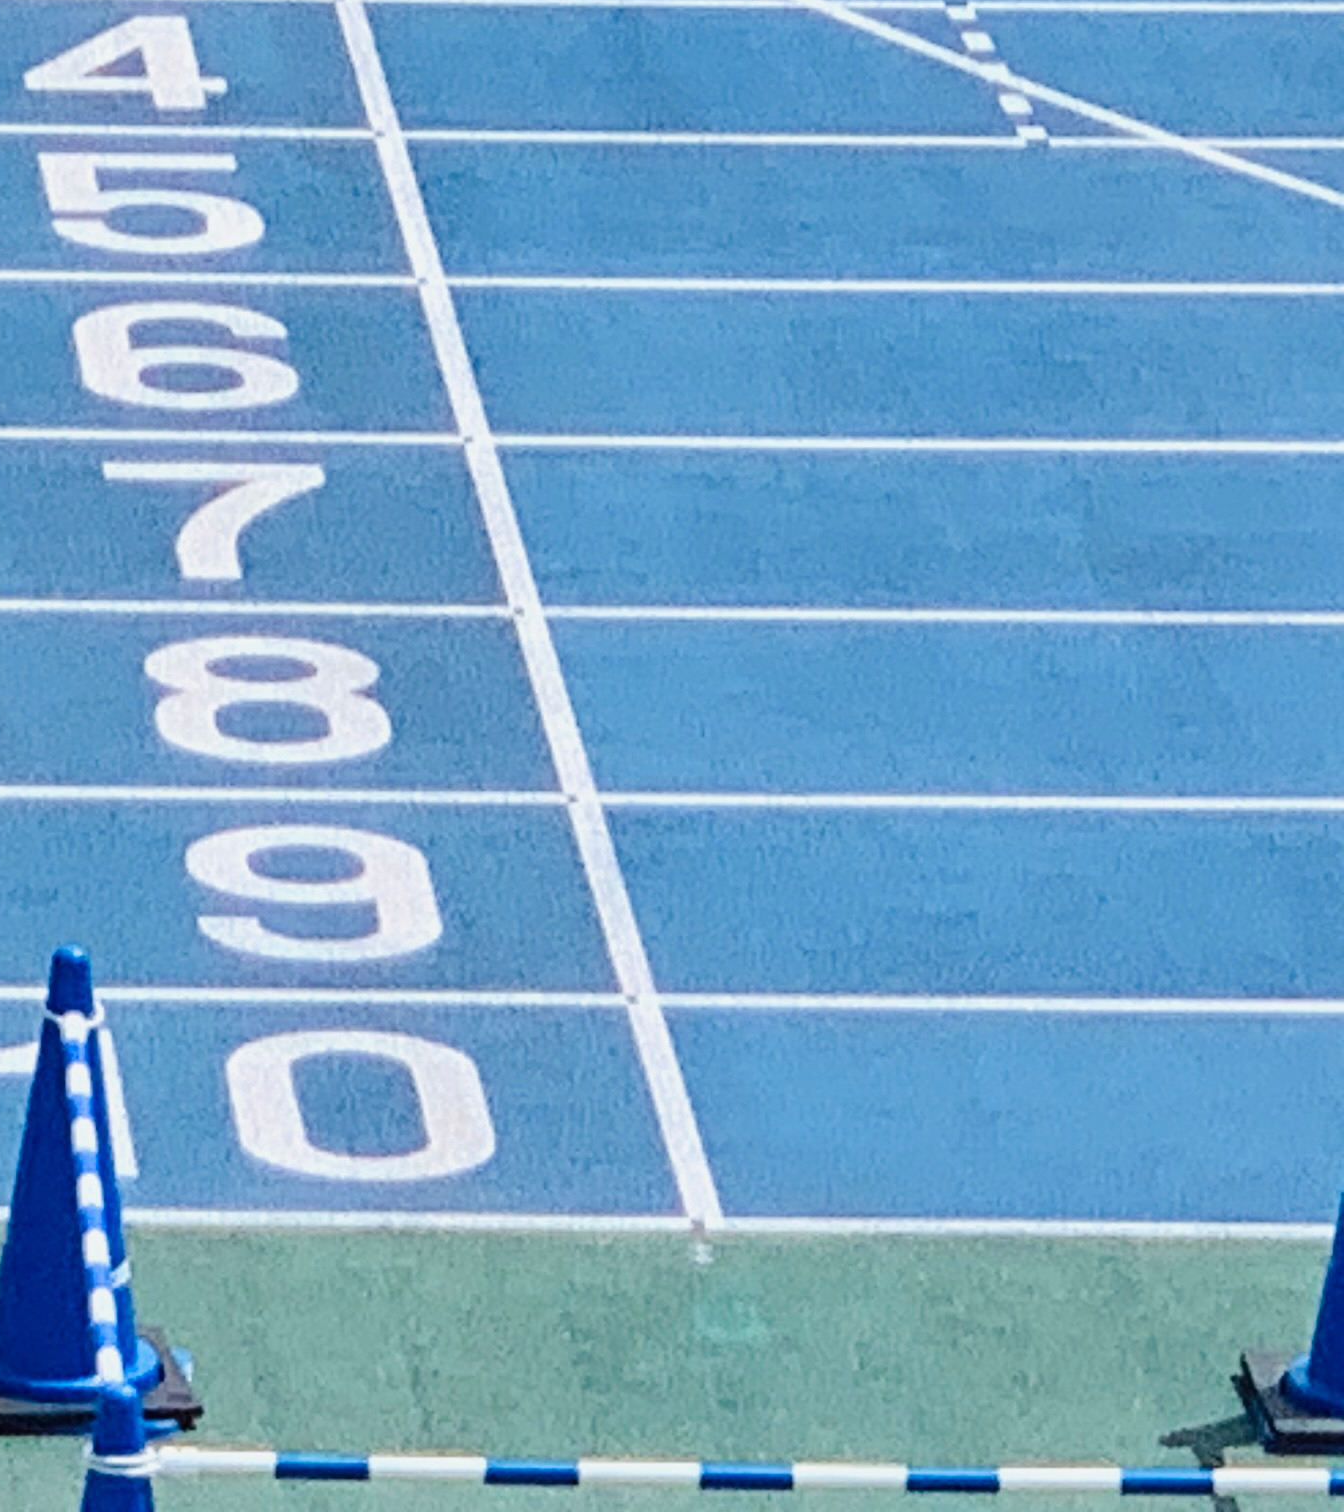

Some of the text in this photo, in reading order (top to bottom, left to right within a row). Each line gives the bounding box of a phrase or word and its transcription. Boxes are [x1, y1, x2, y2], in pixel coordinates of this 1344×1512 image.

[23, 15, 228, 110] 4
[37, 153, 266, 254] 5
[72, 301, 300, 409] 6
[102, 461, 327, 579] 7
[143, 635, 393, 764] 8
[185, 825, 443, 962] 9
